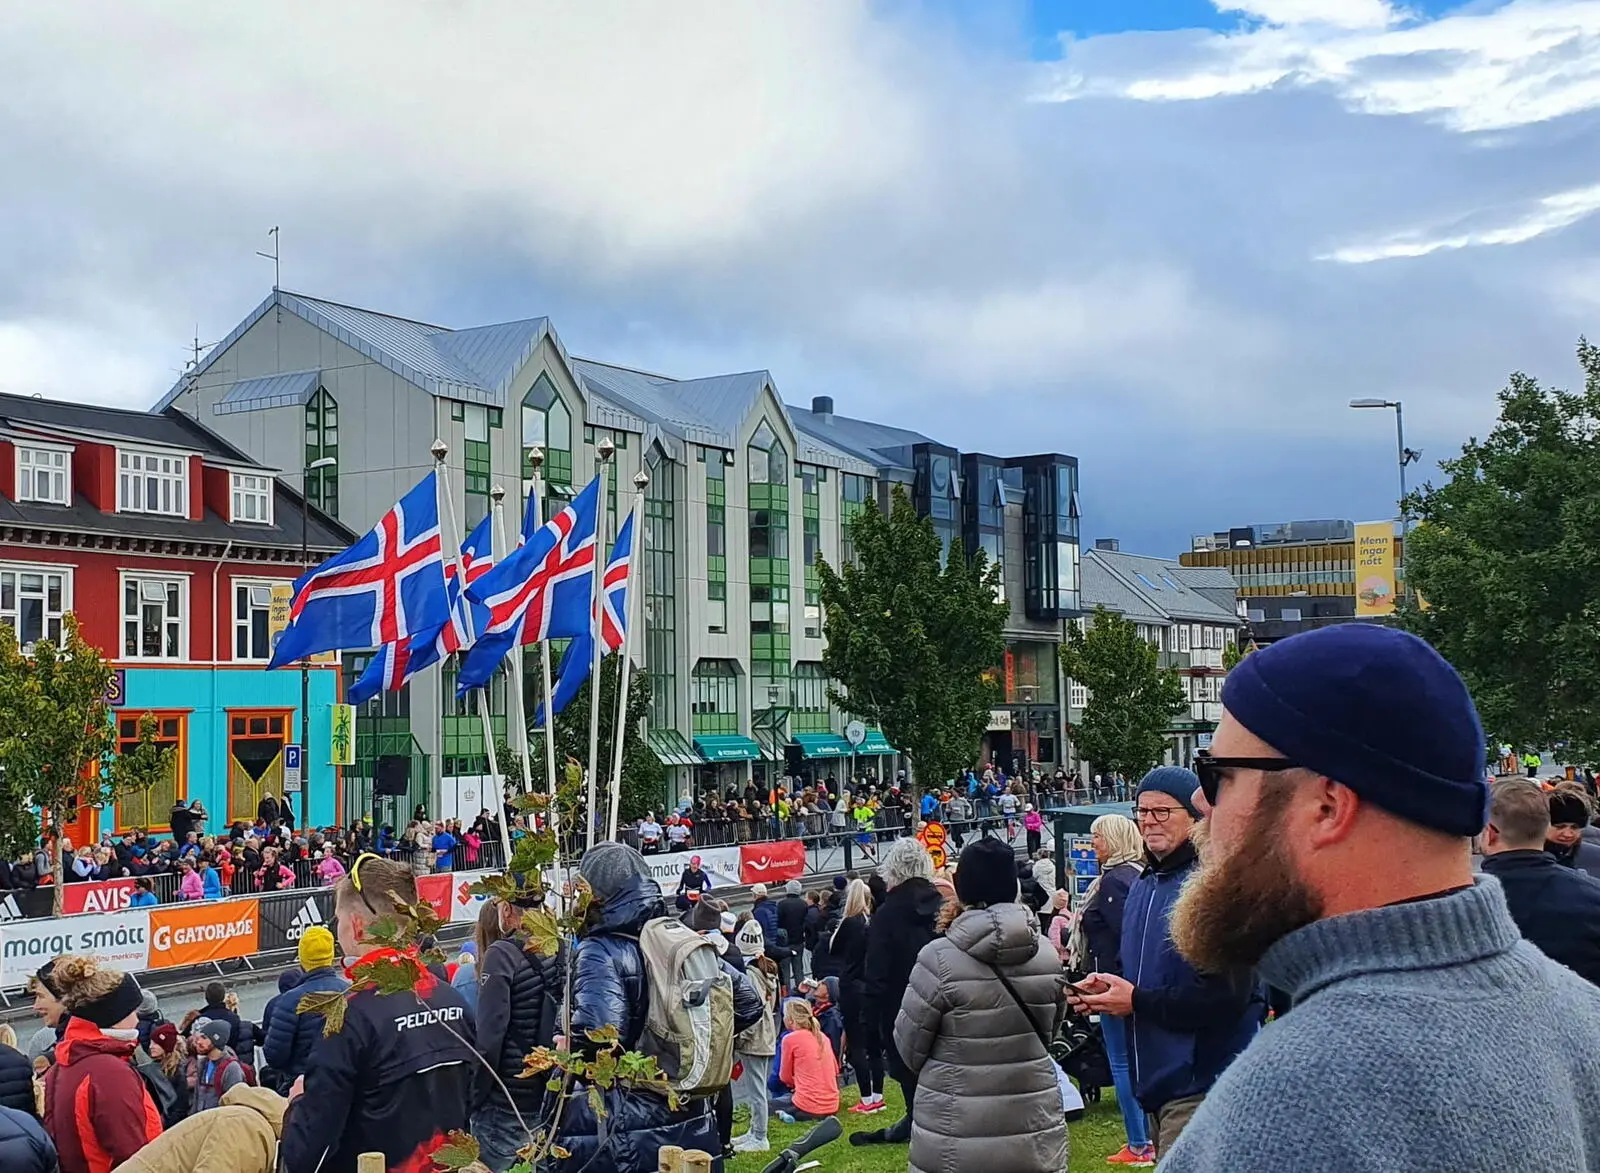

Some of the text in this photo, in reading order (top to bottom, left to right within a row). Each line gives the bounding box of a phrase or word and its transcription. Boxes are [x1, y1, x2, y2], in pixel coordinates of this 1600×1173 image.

[1359, 536, 1388, 545] Menn
[1359, 546, 1387, 556] ingar
[1359, 555, 1383, 566] nótt
[289, 750, 297, 764] P
[650, 861, 680, 878] mátt
[82, 886, 132, 912] AVIS
[4, 924, 145, 958] margt smátt
[153, 919, 253, 951] G GATORADE
[394, 1006, 464, 1032] PELTONEN
